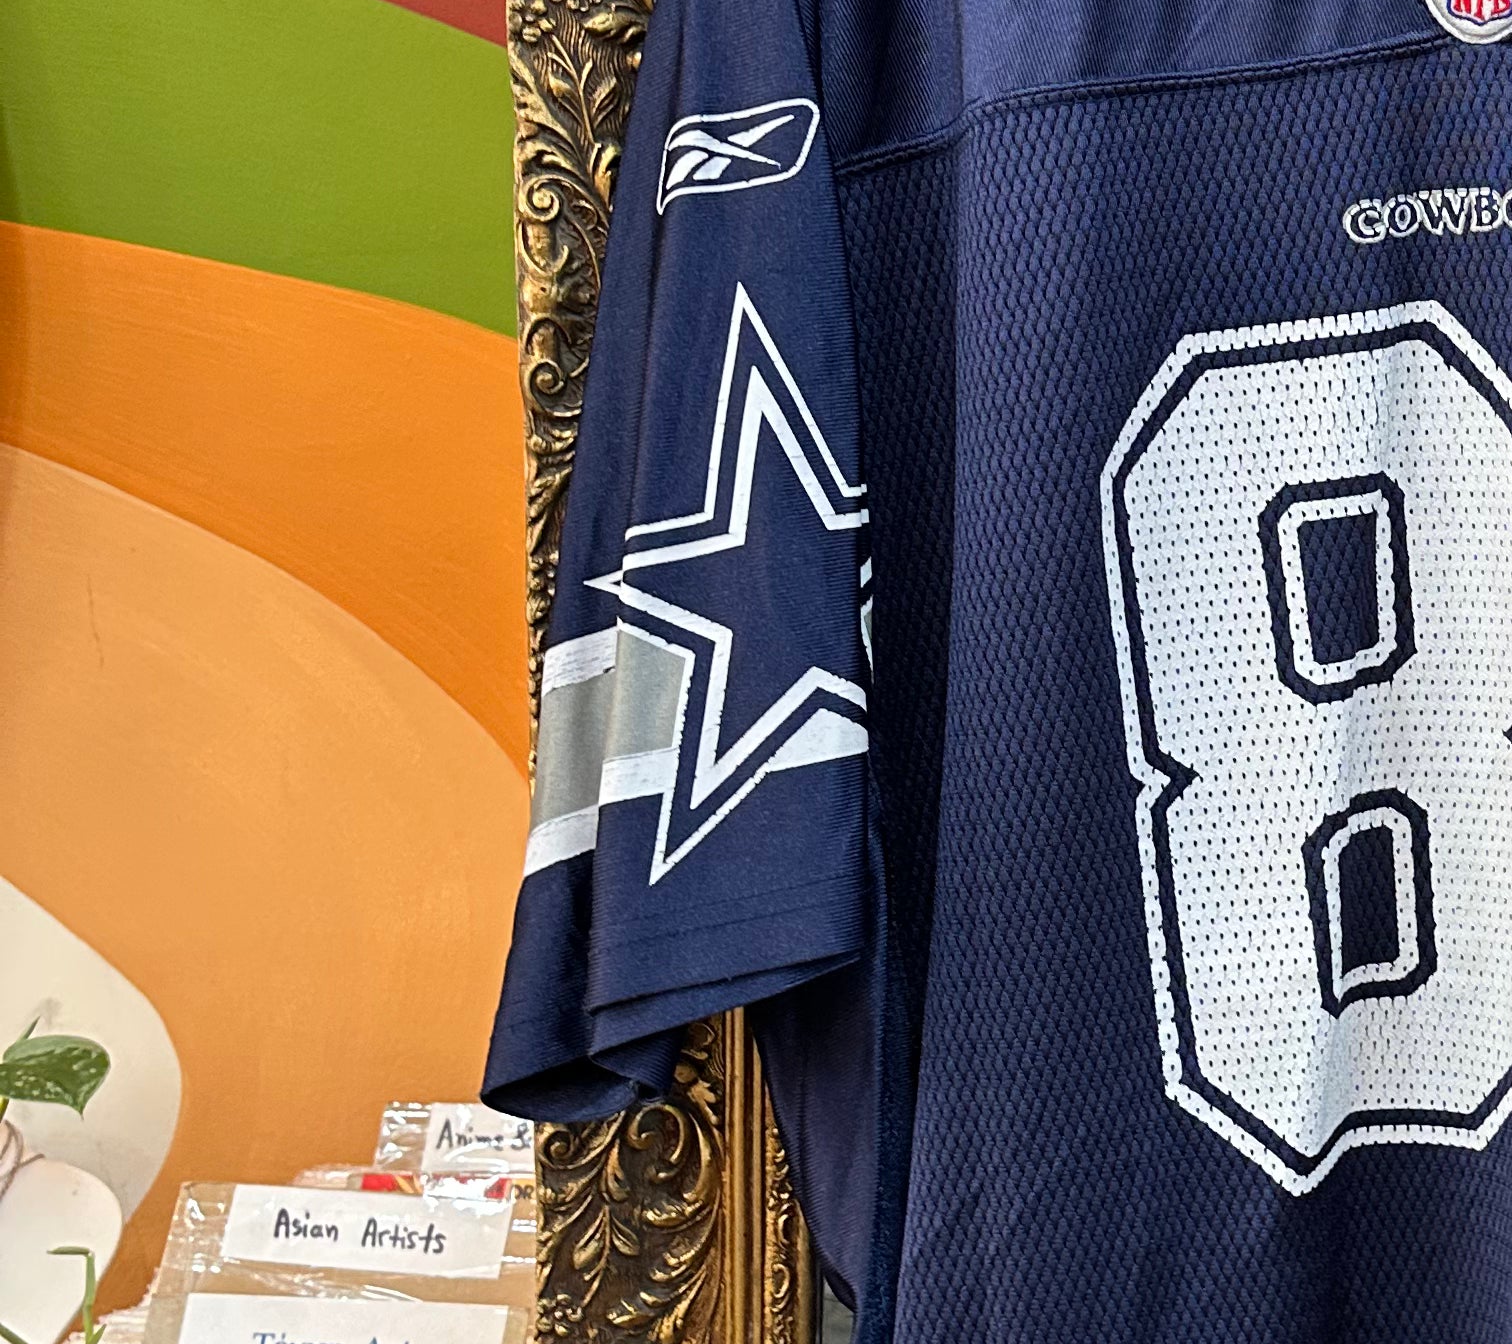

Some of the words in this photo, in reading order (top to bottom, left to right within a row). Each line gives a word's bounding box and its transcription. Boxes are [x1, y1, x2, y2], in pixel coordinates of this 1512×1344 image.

[436, 1118, 504, 1151] Anime
[273, 1208, 339, 1242] Asian
[361, 1218, 446, 1254] Artists
